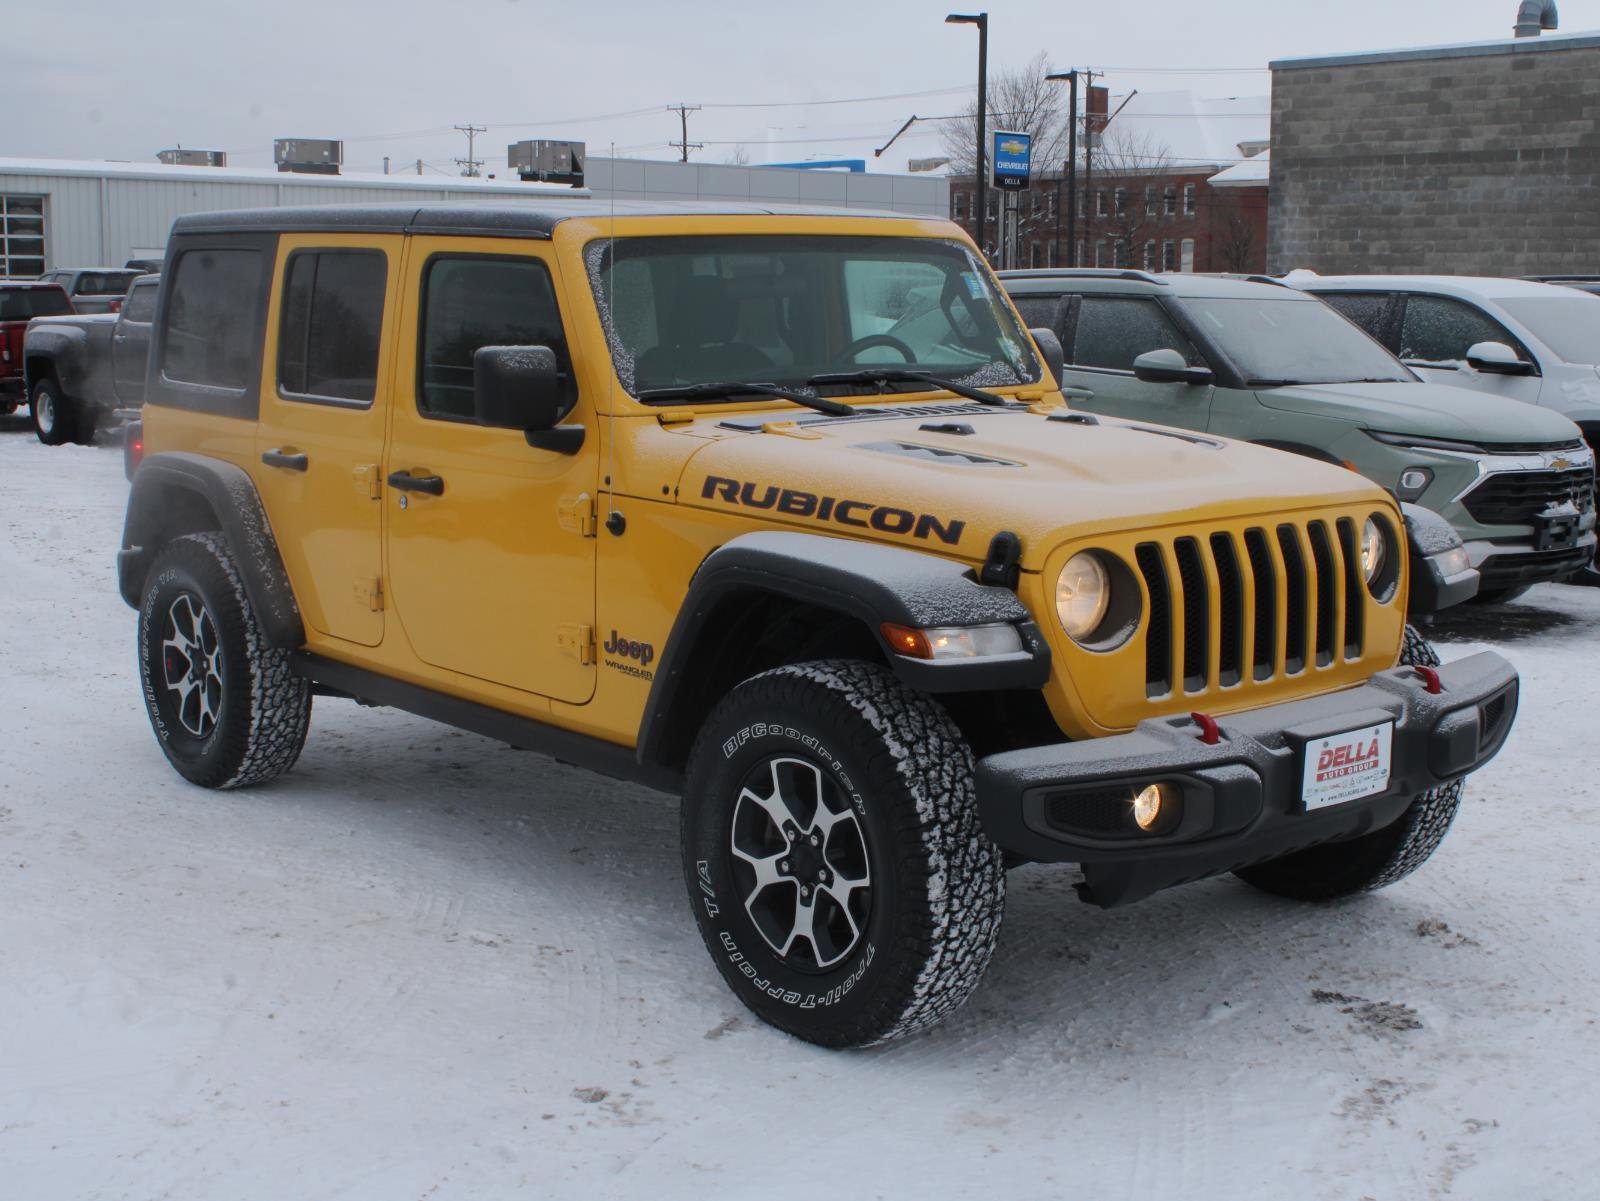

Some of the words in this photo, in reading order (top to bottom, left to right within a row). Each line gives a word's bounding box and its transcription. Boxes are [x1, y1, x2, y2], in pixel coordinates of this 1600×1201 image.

[997, 161, 1029, 170] CHEVROLET
[701, 475, 966, 546] RUBICON
[604, 630, 654, 666] Jeep
[605, 658, 653, 677] WRANGLER
[722, 723, 866, 815] BFGoodrich
[1318, 738, 1379, 770] DELLA
[1323, 768, 1345, 779] AUTO
[1348, 761, 1374, 773] GROUP
[697, 861, 720, 918] T/A
